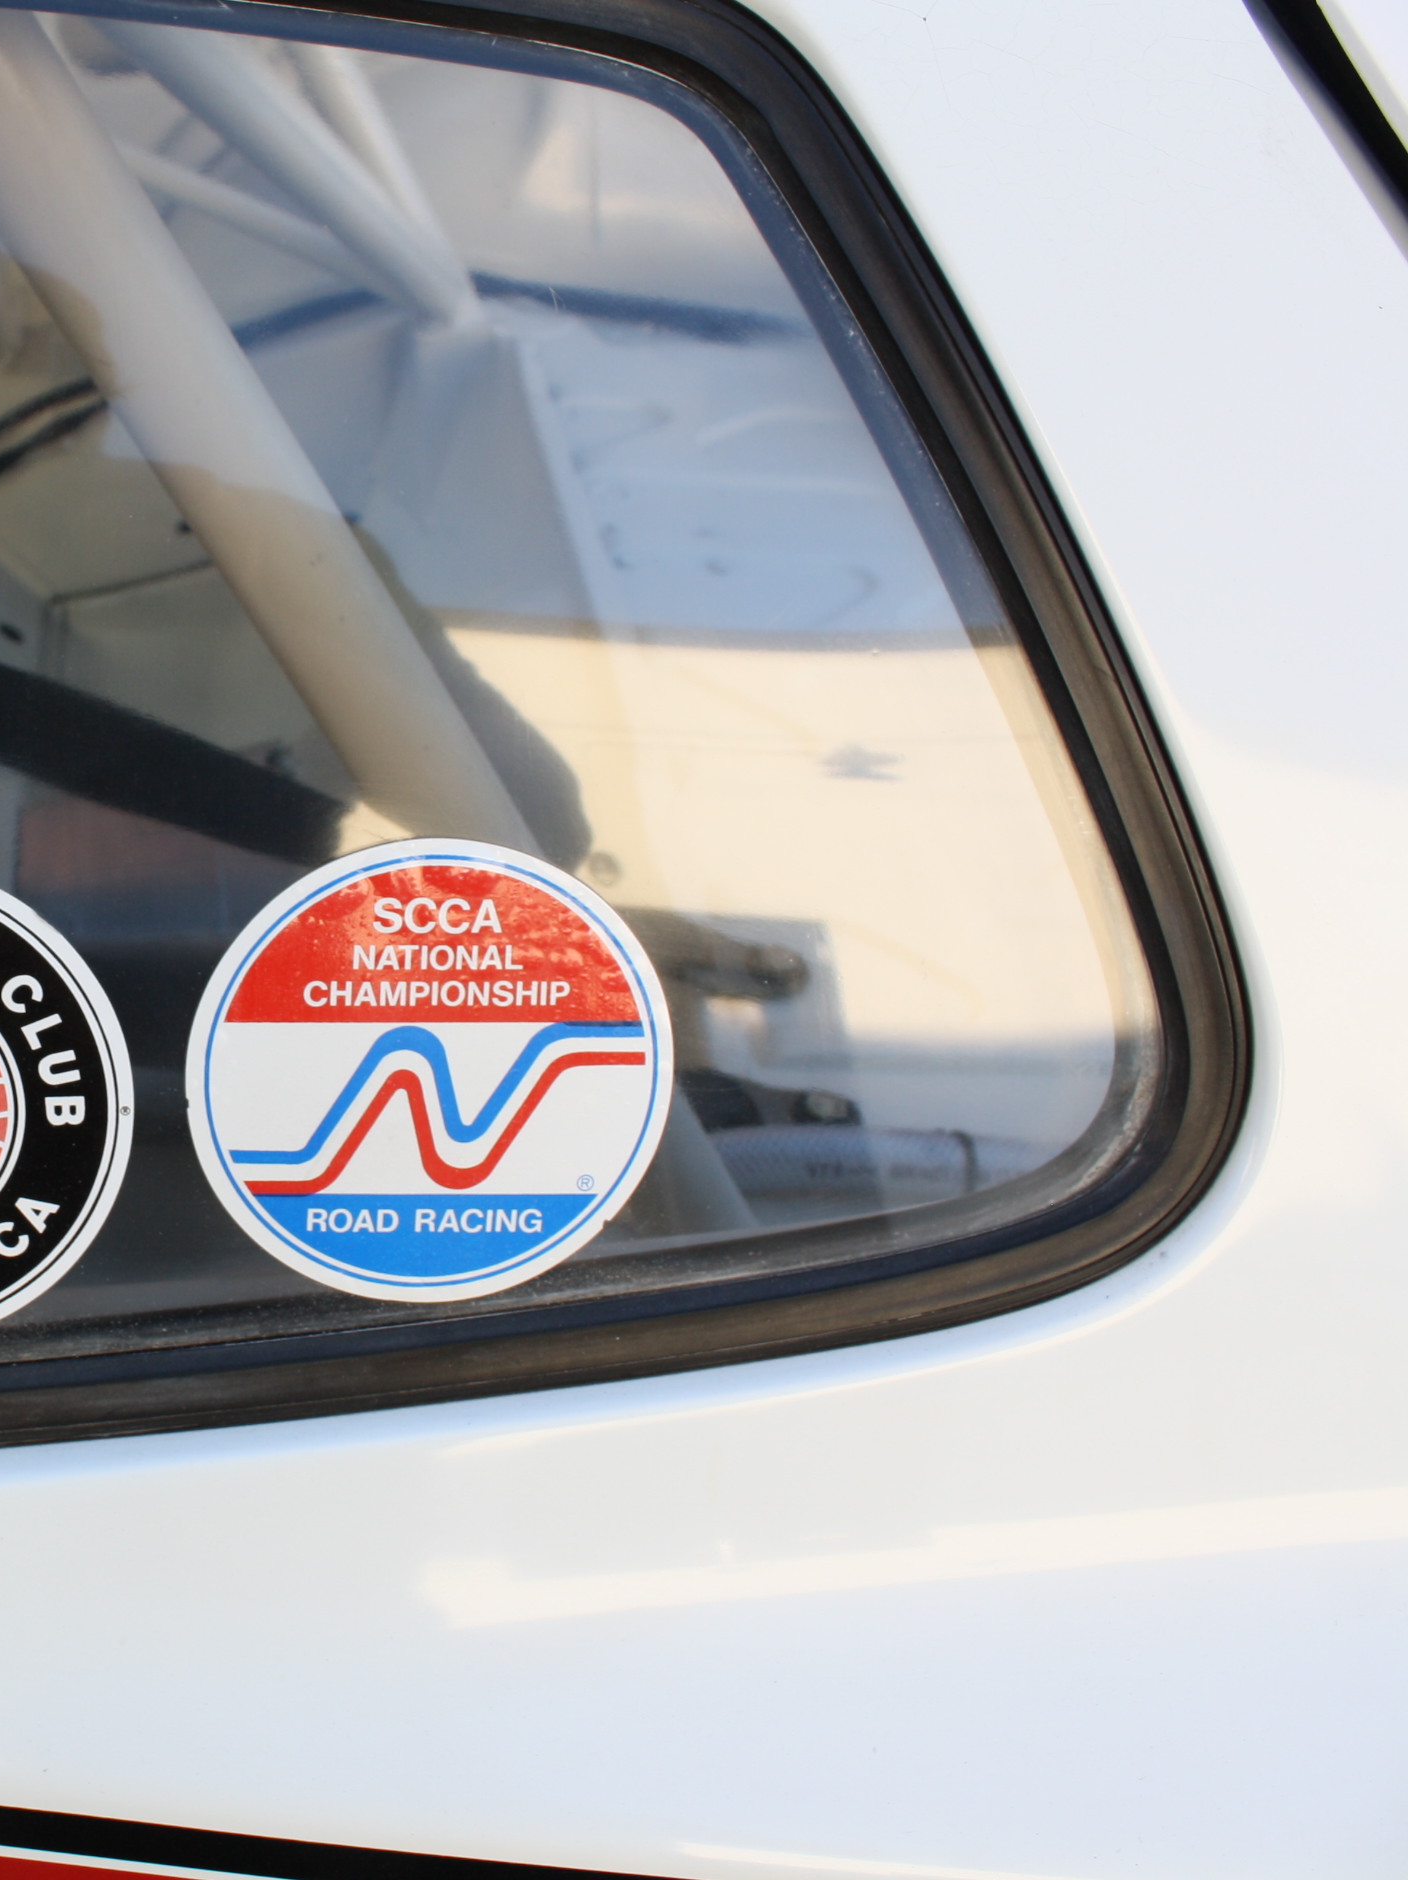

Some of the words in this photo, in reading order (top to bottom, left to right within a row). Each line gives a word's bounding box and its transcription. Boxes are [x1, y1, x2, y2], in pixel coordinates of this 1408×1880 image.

[372, 898, 503, 934] SCCA
[352, 945, 523, 971] NATIONAL
[303, 980, 571, 1008] CHAMPIONSHIP
[0, 974, 86, 1127] CLUB
[305, 1208, 400, 1233] ROAD
[413, 1208, 544, 1233] RACING
